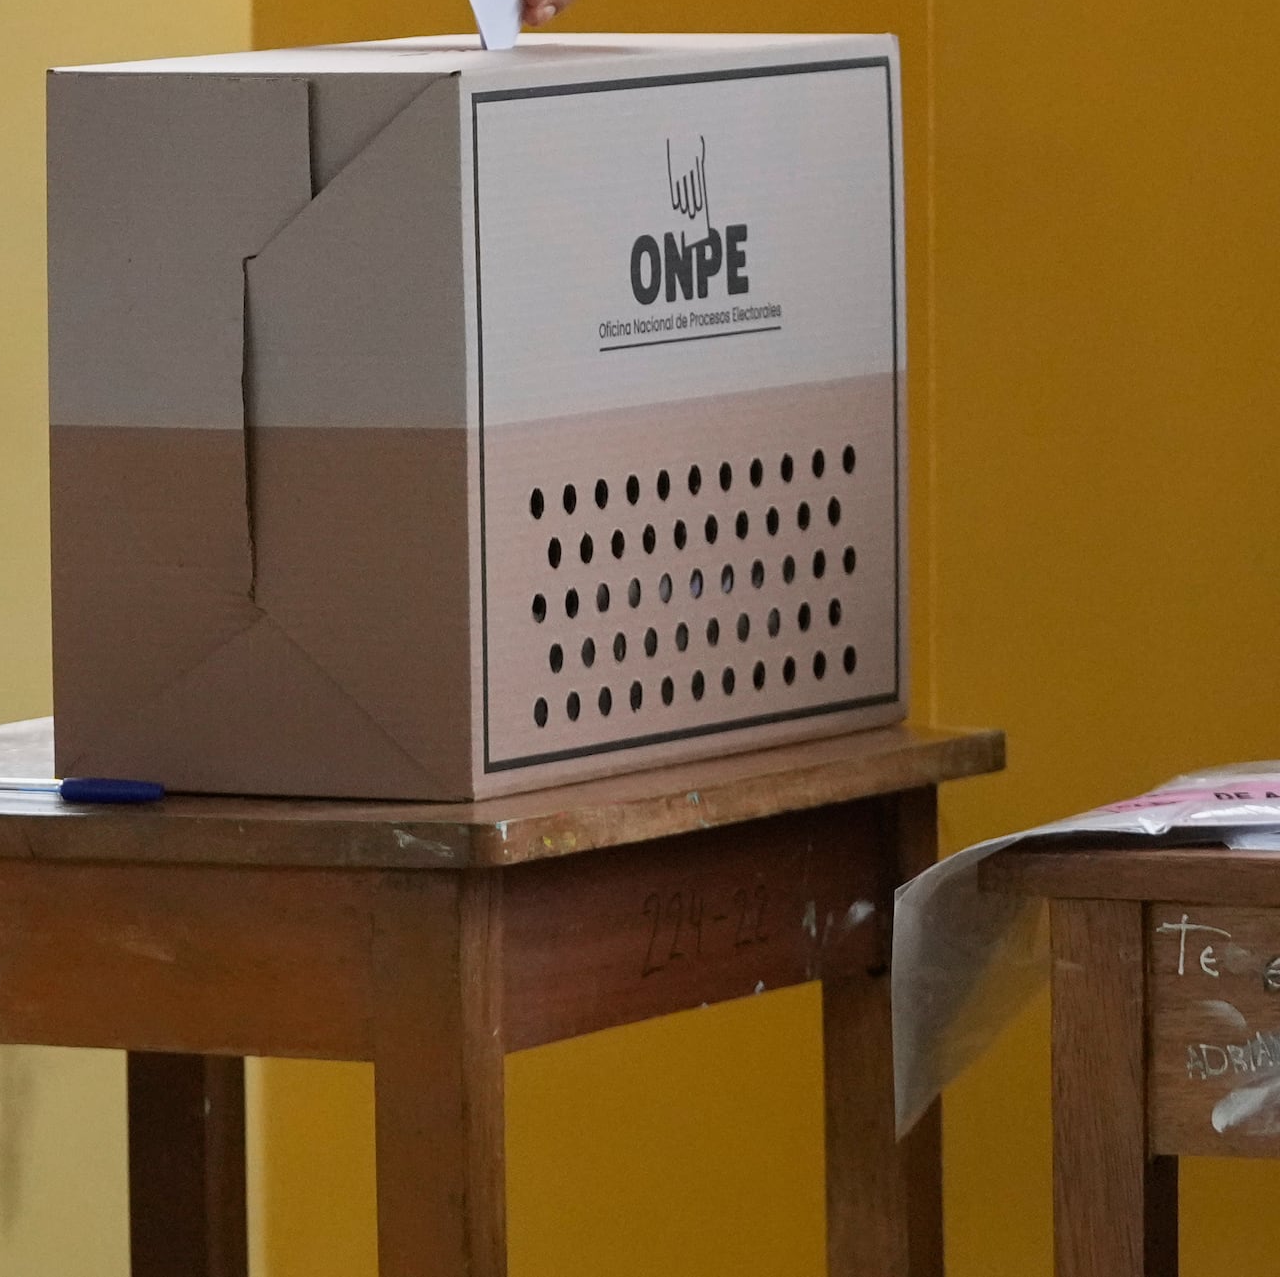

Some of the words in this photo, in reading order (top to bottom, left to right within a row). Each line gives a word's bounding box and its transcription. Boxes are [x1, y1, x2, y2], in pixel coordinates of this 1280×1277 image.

[630, 224, 749, 305] ONPE
[599, 322, 631, 338] Oficina
[633, 316, 674, 334] Nacional
[675, 312, 688, 329] de
[689, 309, 730, 328] Procesos
[732, 302, 782, 322] Electorales
[1212, 791, 1252, 801] DE
